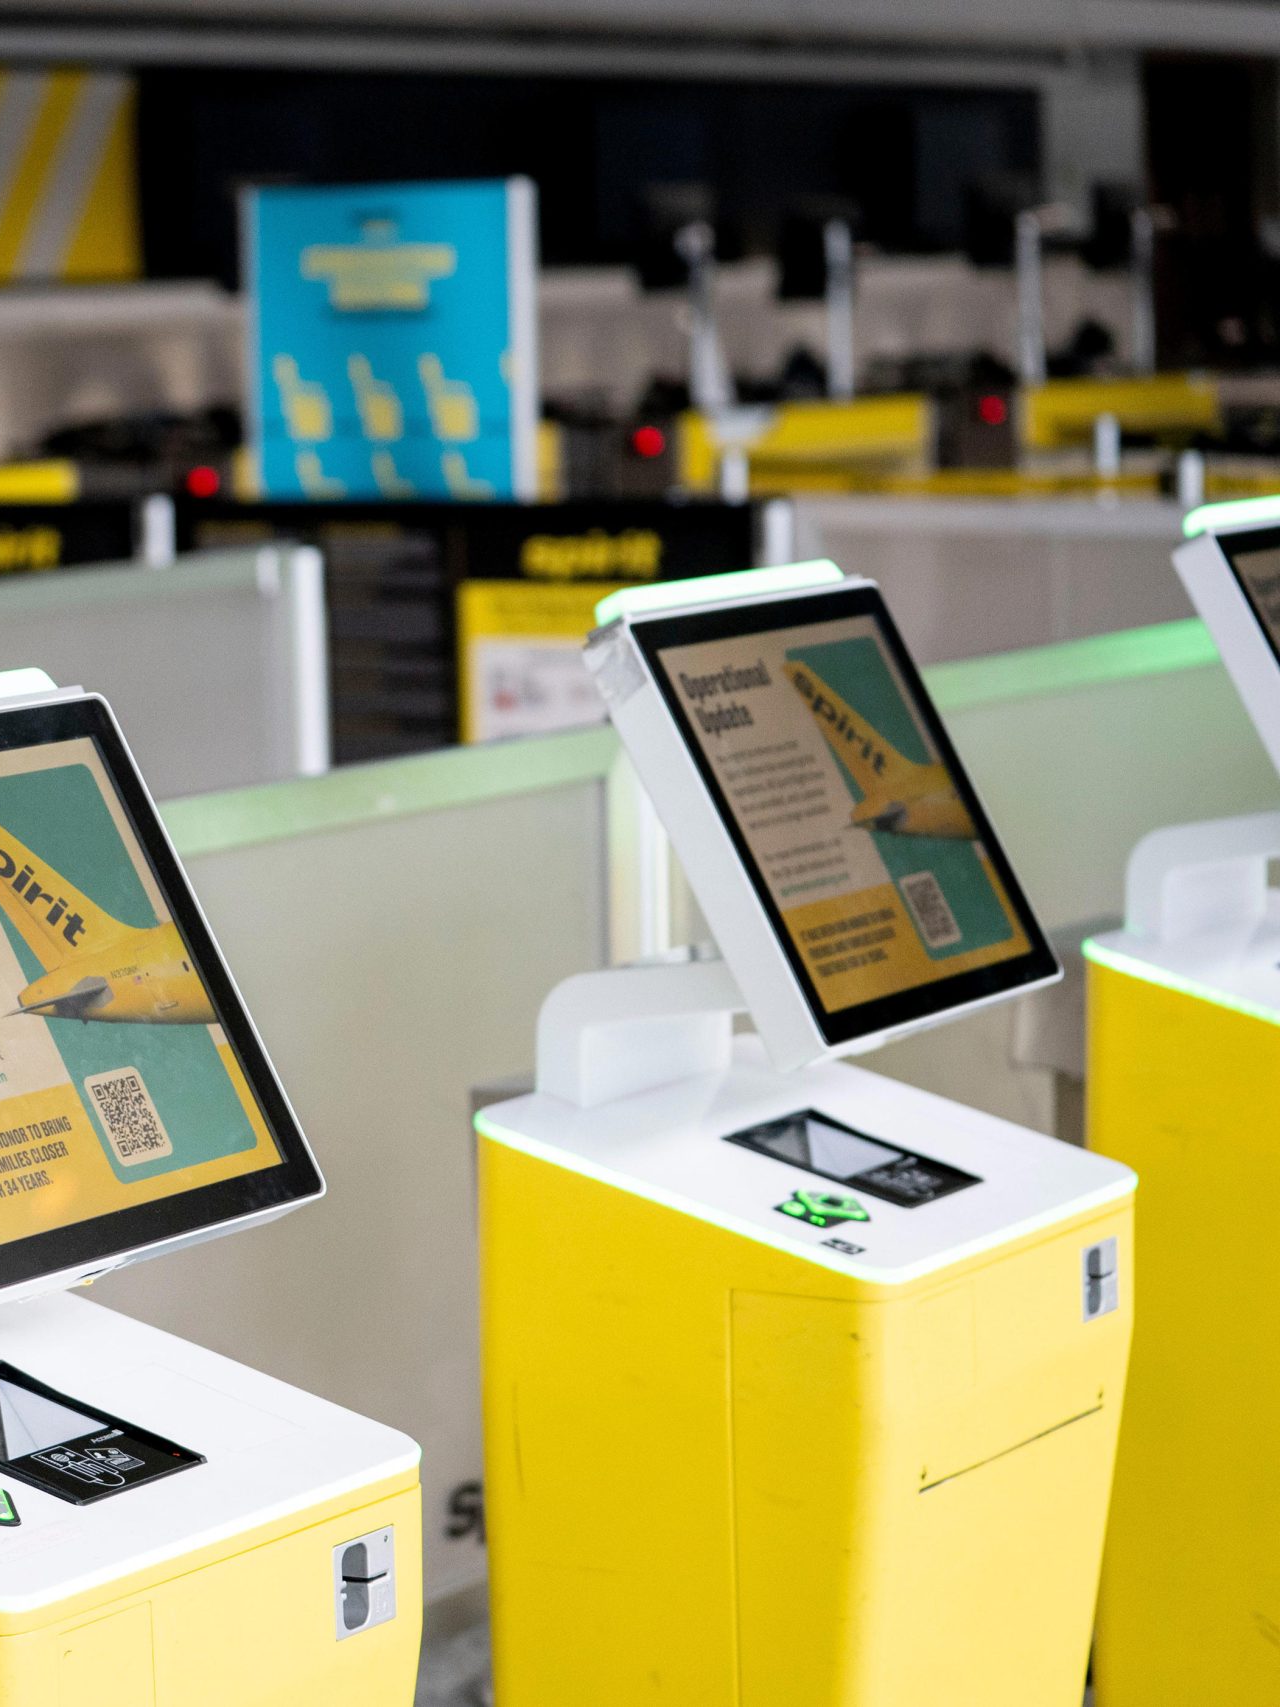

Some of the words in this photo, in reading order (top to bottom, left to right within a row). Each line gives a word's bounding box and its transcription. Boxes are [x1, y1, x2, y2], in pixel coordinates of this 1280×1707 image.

[678, 658, 772, 703] Operational
[694, 701, 754, 738] Update
[793, 672, 885, 774] spirit
[26, 1123, 42, 1140] TO
[38, 1115, 72, 1137] BRING
[32, 1141, 69, 1164] CLOSER
[4, 1179, 20, 1196] 34
[18, 1170, 54, 1191] YEARS.
